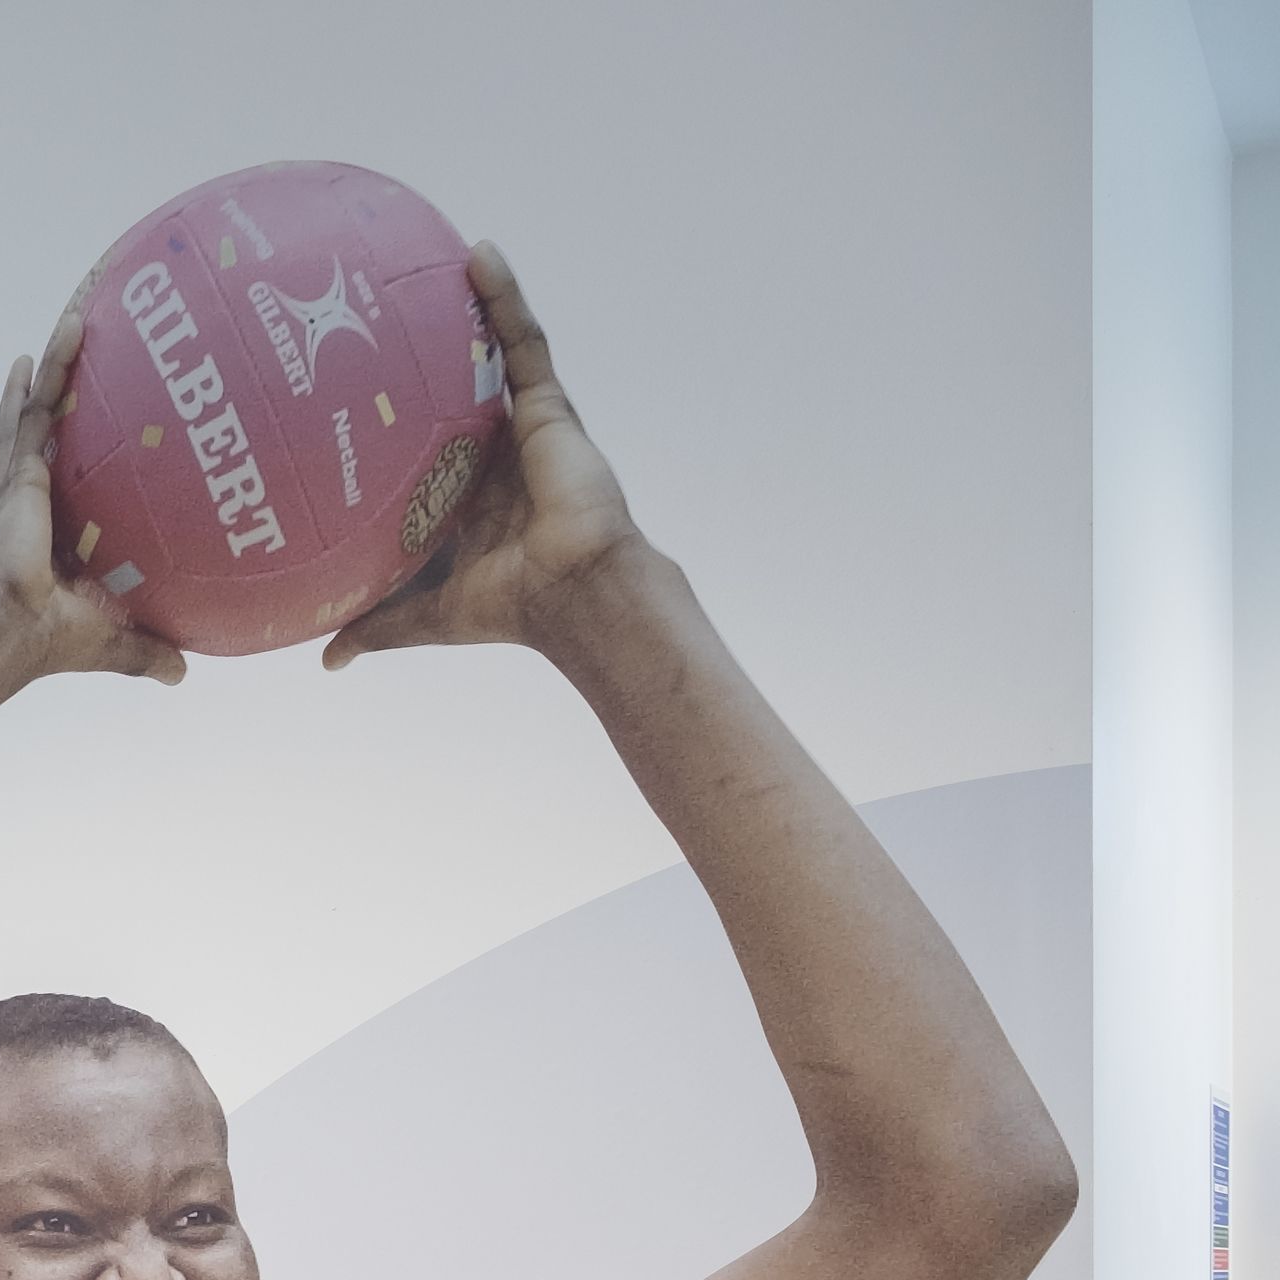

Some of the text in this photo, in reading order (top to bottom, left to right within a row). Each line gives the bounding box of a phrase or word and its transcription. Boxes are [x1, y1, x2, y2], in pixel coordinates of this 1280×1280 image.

[247, 281, 313, 397] GILBERT
[121, 261, 287, 558] GILBERT
[332, 408, 362, 507] Netball
